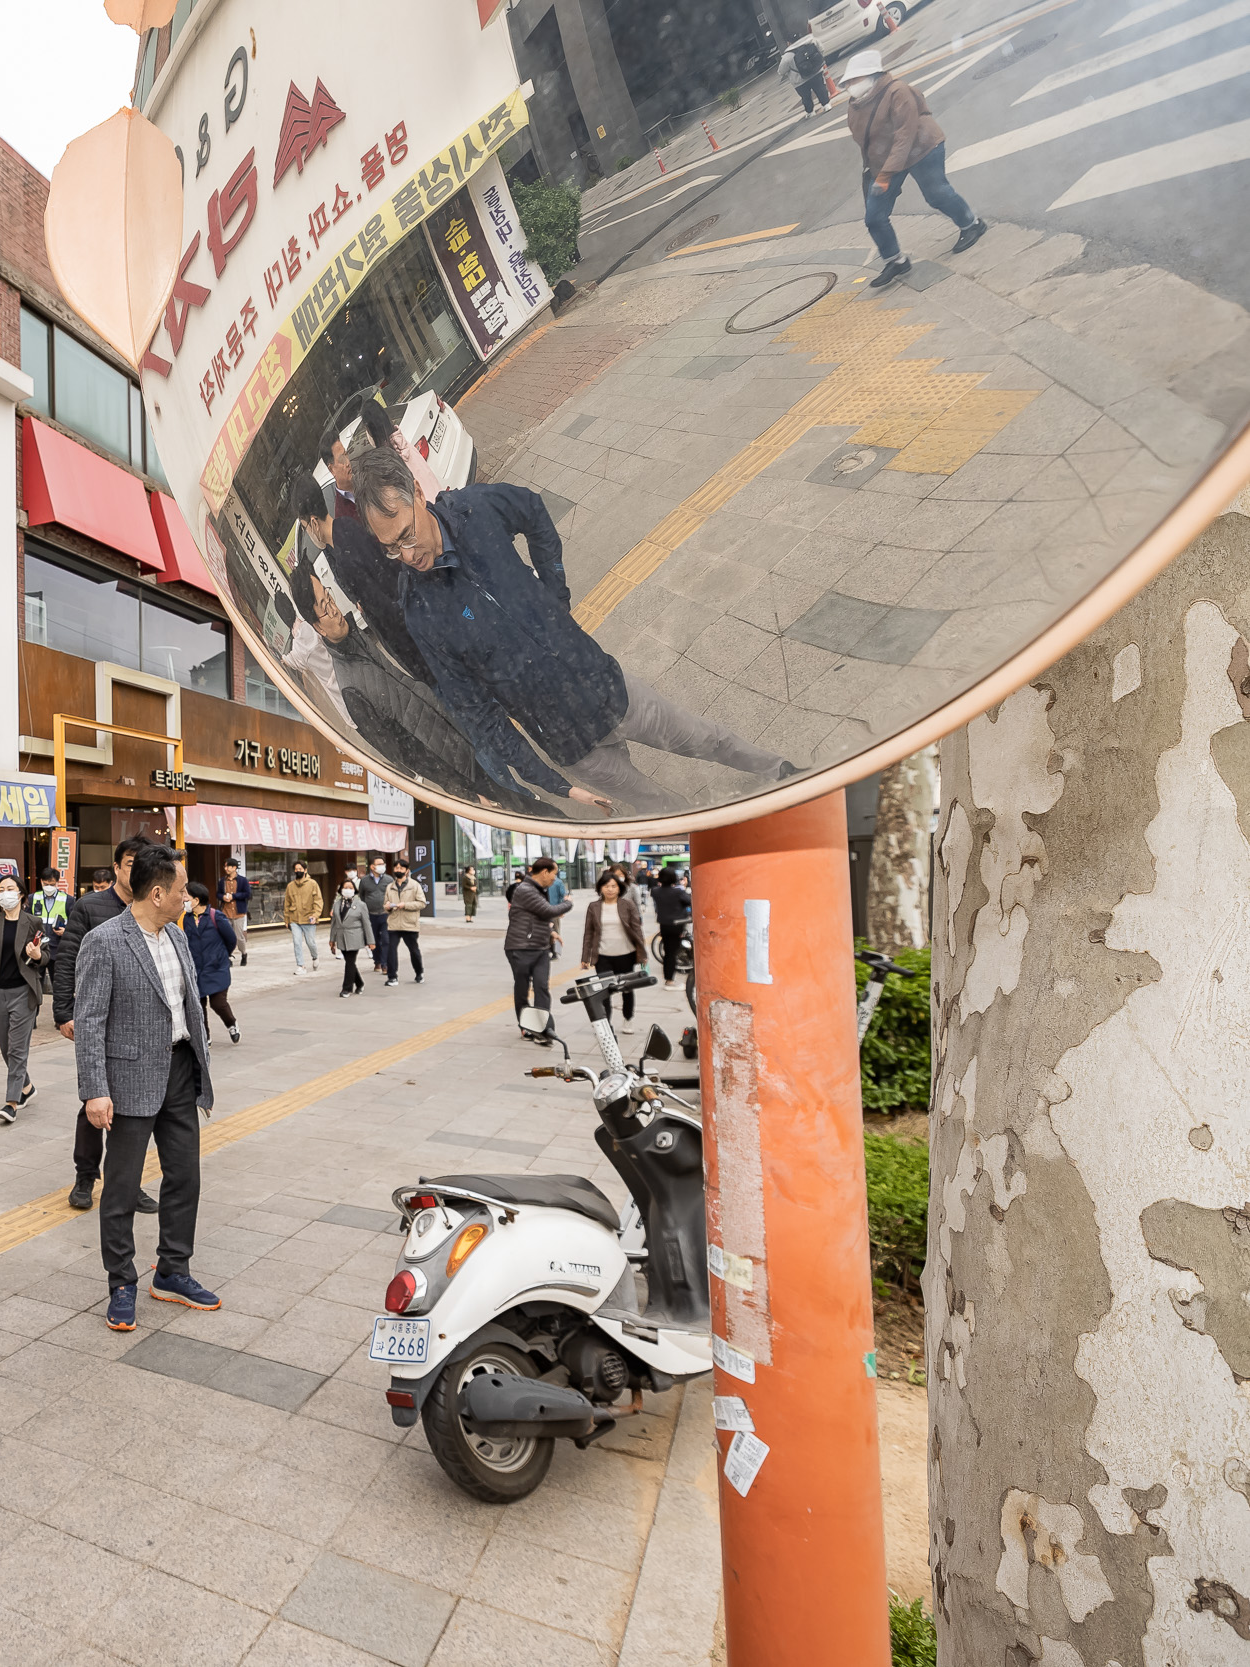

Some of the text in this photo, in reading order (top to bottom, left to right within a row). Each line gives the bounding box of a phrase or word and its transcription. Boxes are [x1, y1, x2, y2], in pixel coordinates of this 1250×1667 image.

[235, 738, 262, 768] 가구
[266, 745, 276, 769] &
[279, 747, 321, 779] 인테리어
[154, 769, 196, 791] 트라바스
[258, 816, 321, 847] 붙박이장
[327, 822, 369, 849] 전문점
[388, 1336, 425, 1357] 2668
